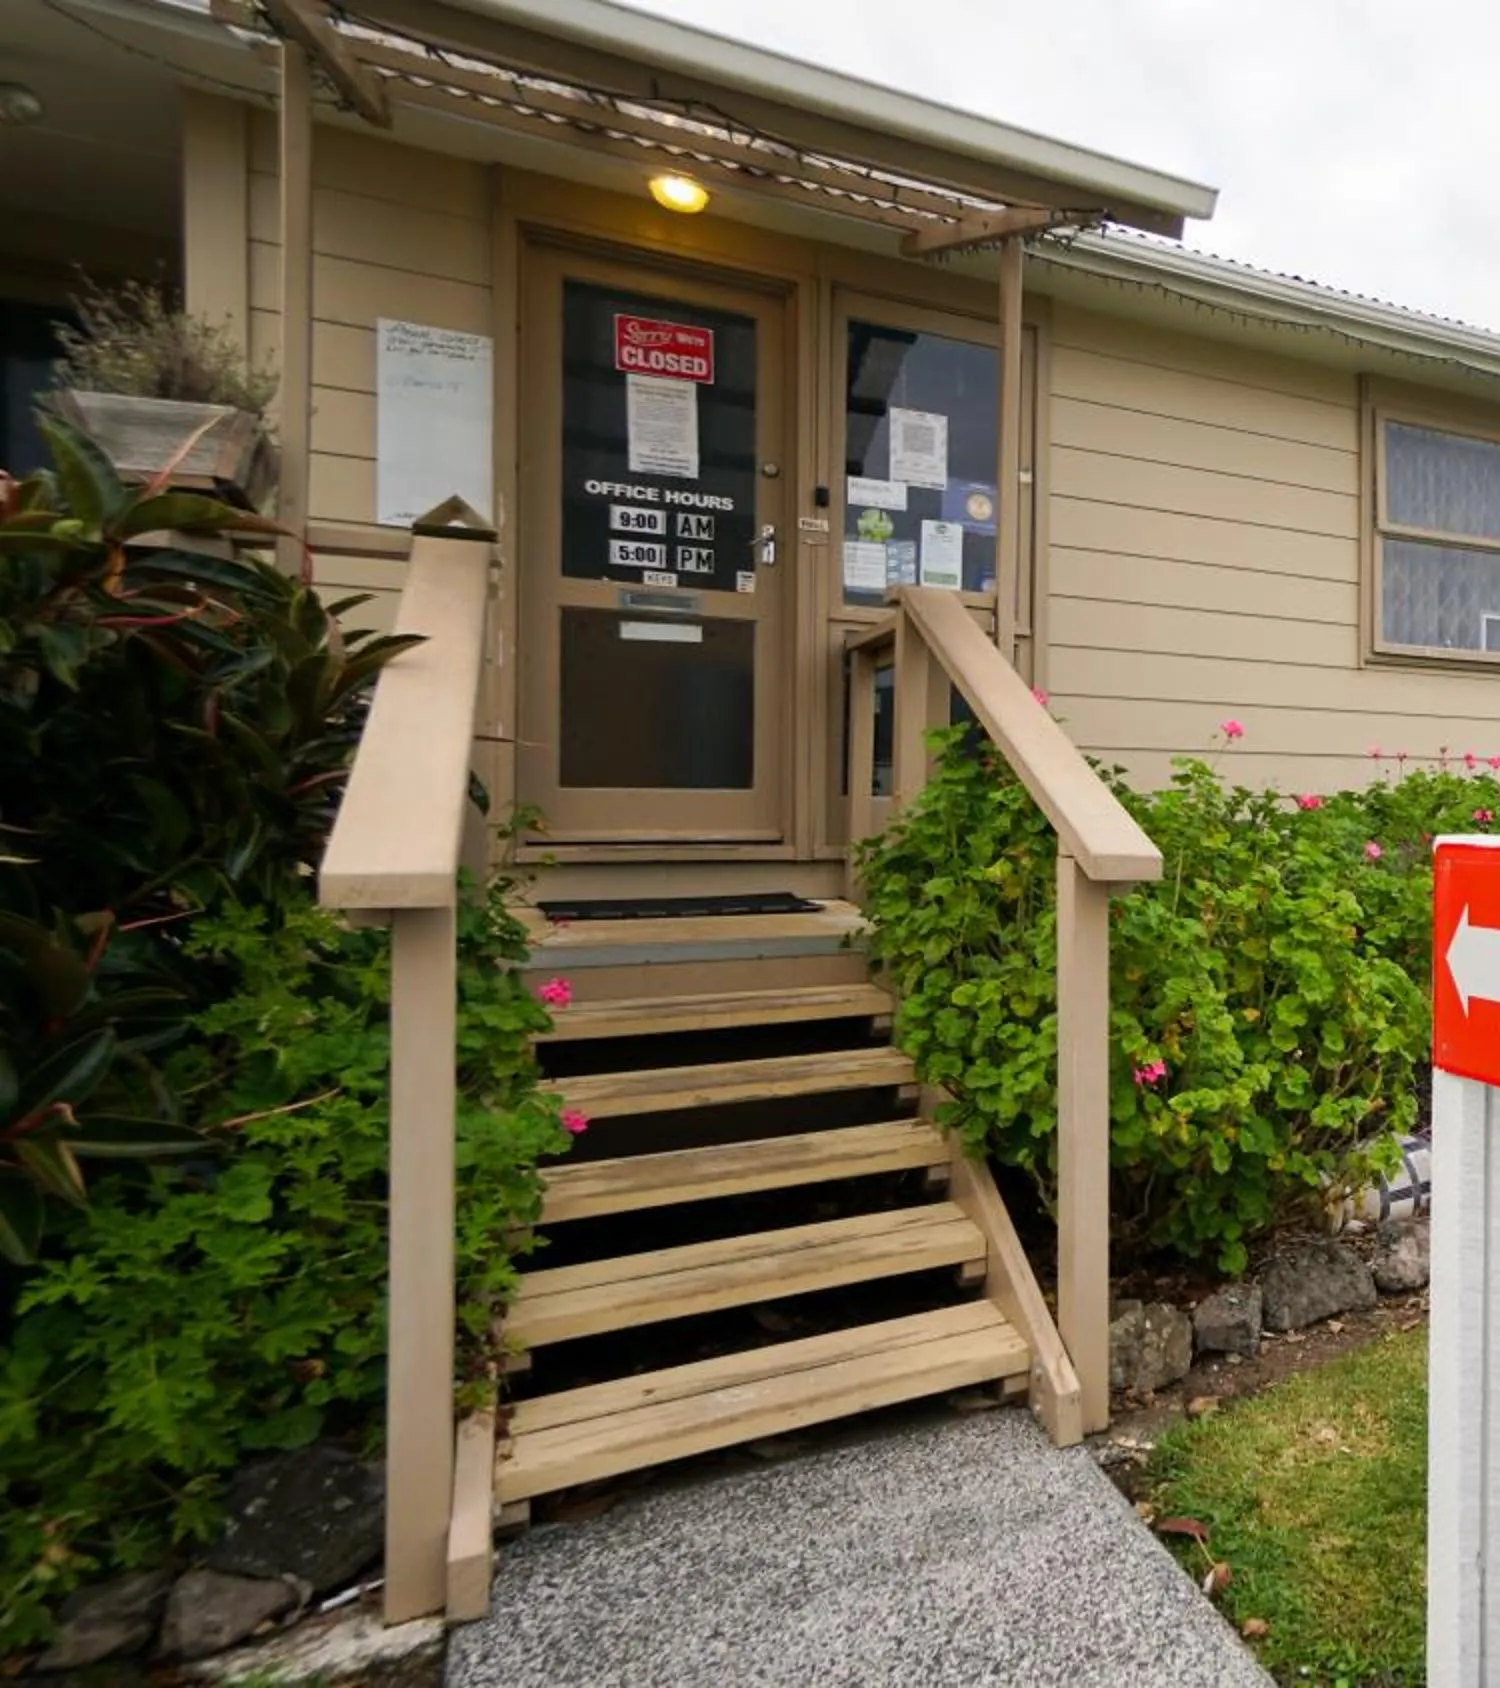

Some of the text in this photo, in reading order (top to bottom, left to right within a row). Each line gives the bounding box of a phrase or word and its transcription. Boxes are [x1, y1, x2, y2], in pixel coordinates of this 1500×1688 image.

[621, 345, 708, 376] CLOSED
[584, 480, 734, 511] OFFICE HOURS
[619, 511, 713, 538] 9:00 AM
[618, 544, 713, 571] 5:00 PM
